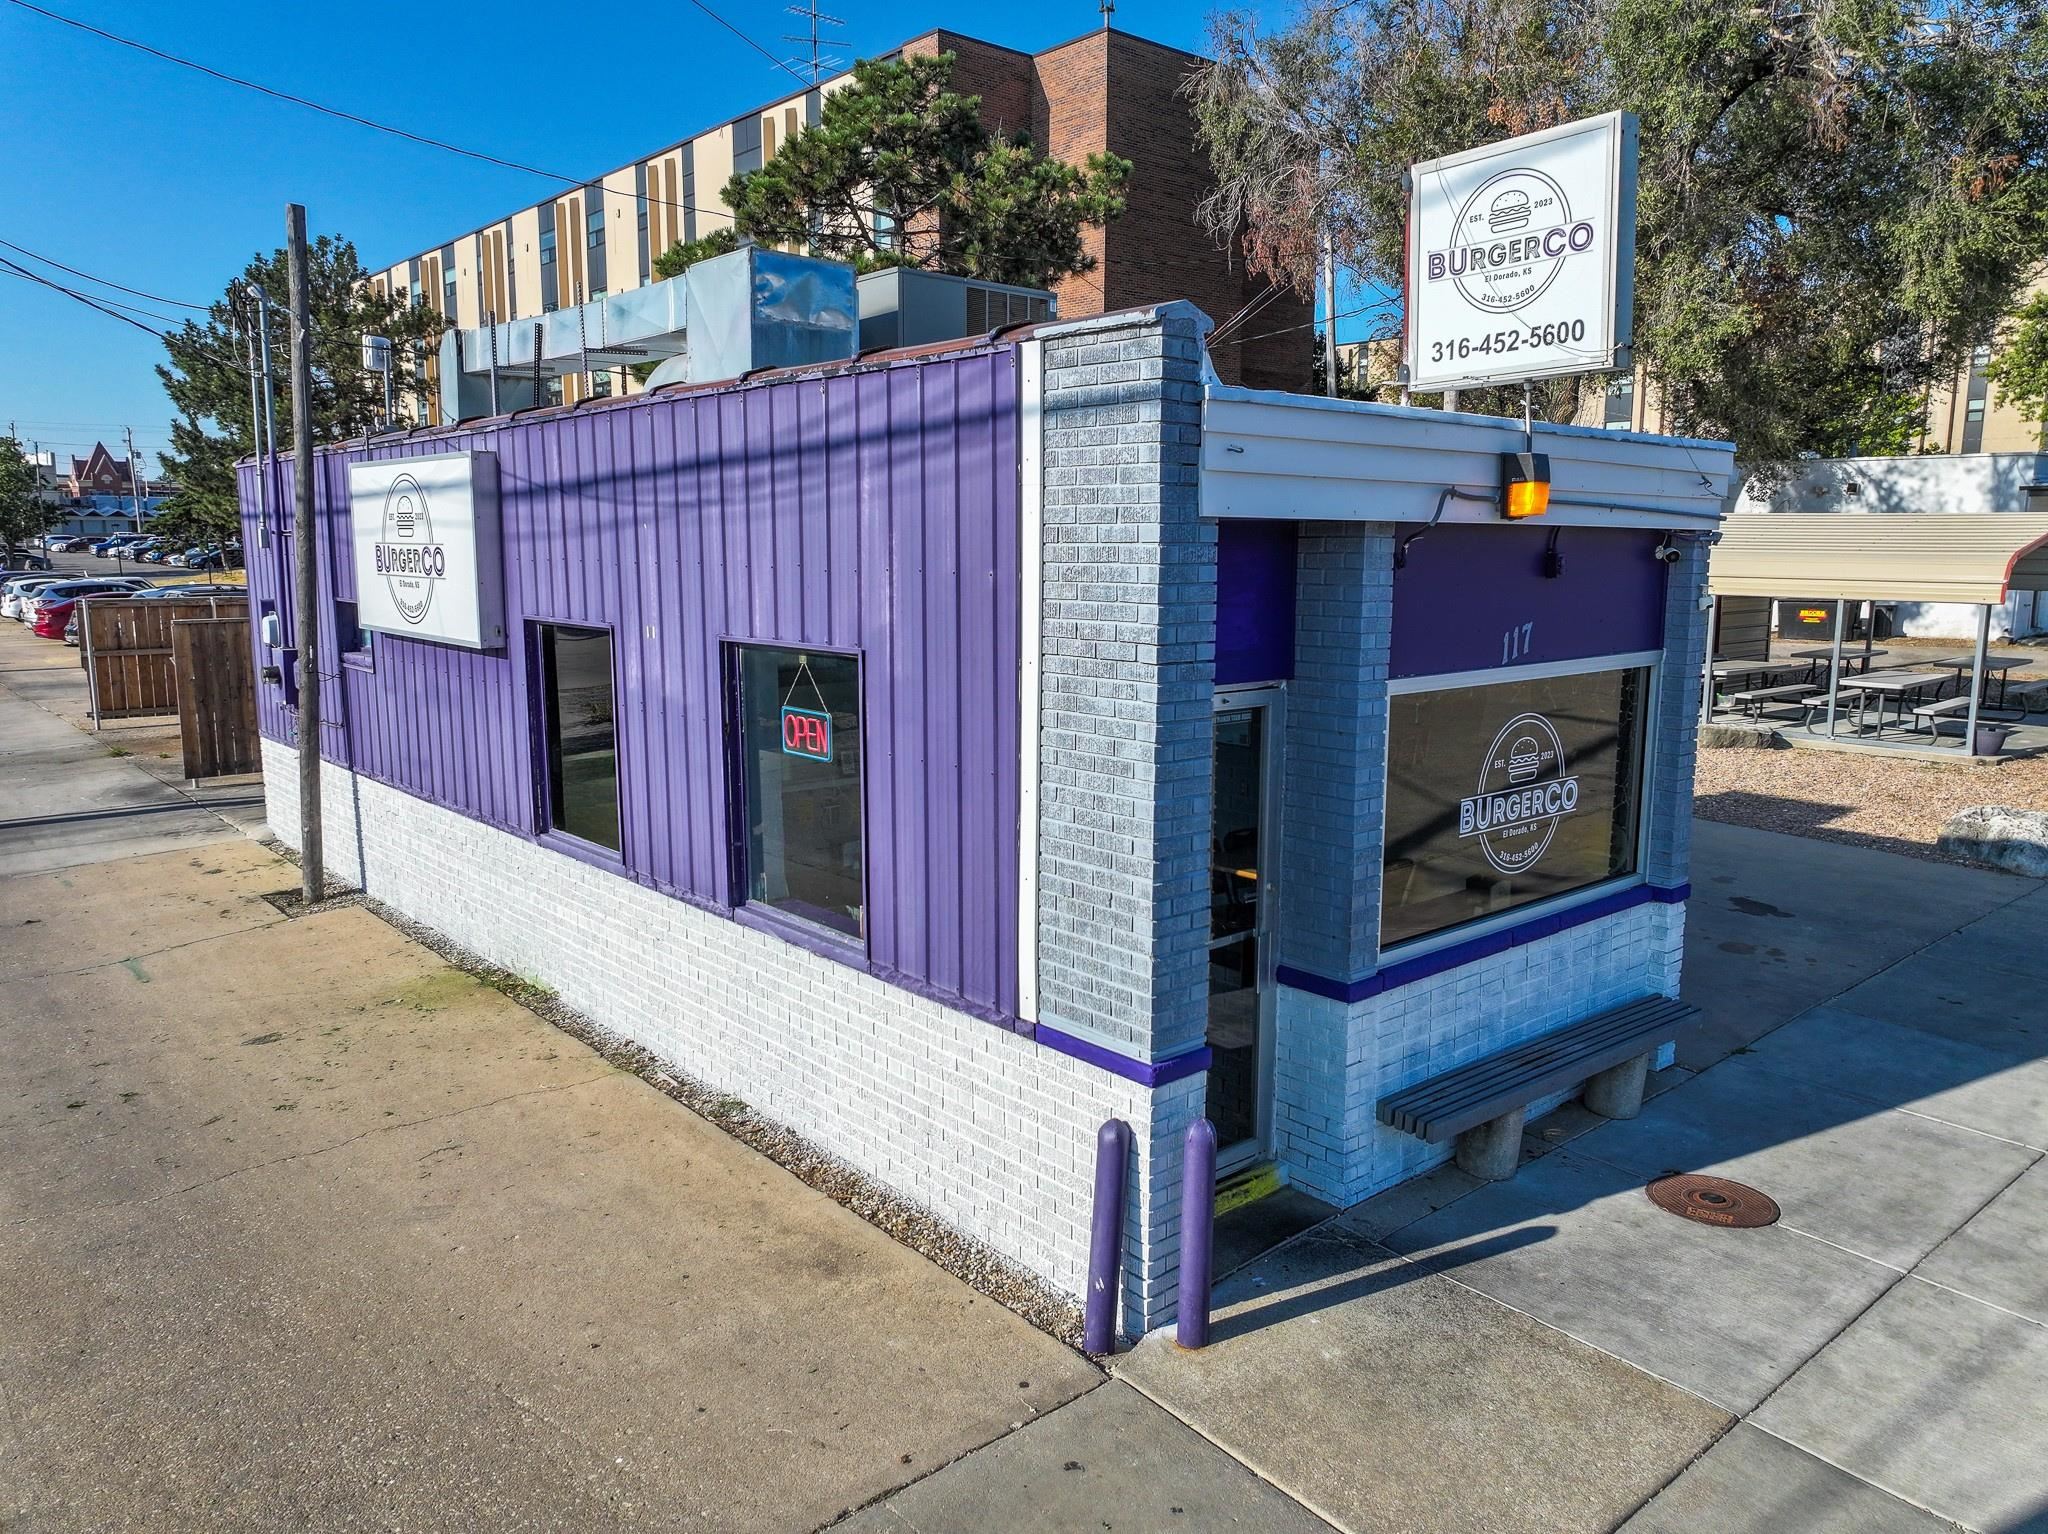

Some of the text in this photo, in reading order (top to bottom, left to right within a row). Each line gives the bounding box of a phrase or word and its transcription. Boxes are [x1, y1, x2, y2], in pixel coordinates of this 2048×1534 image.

[1533, 197, 1553, 209] 2023
[1469, 213, 1484, 224] EST.
[1428, 222, 1594, 281] BURGERCO
[1484, 267, 1532, 283] El Dorado, KS
[1481, 285, 1535, 303] 316-452-5600
[1431, 319, 1585, 362] 316-452-5600
[375, 544, 445, 577] BURGERCO
[1501, 620, 1534, 665] 117
[784, 714, 828, 755] OPEN
[1494, 760, 1506, 768] EST.
[1541, 750, 1554, 760] 2023
[1459, 779, 1578, 834] BURGERCO
[1499, 842, 1539, 862] 316-452-5600
